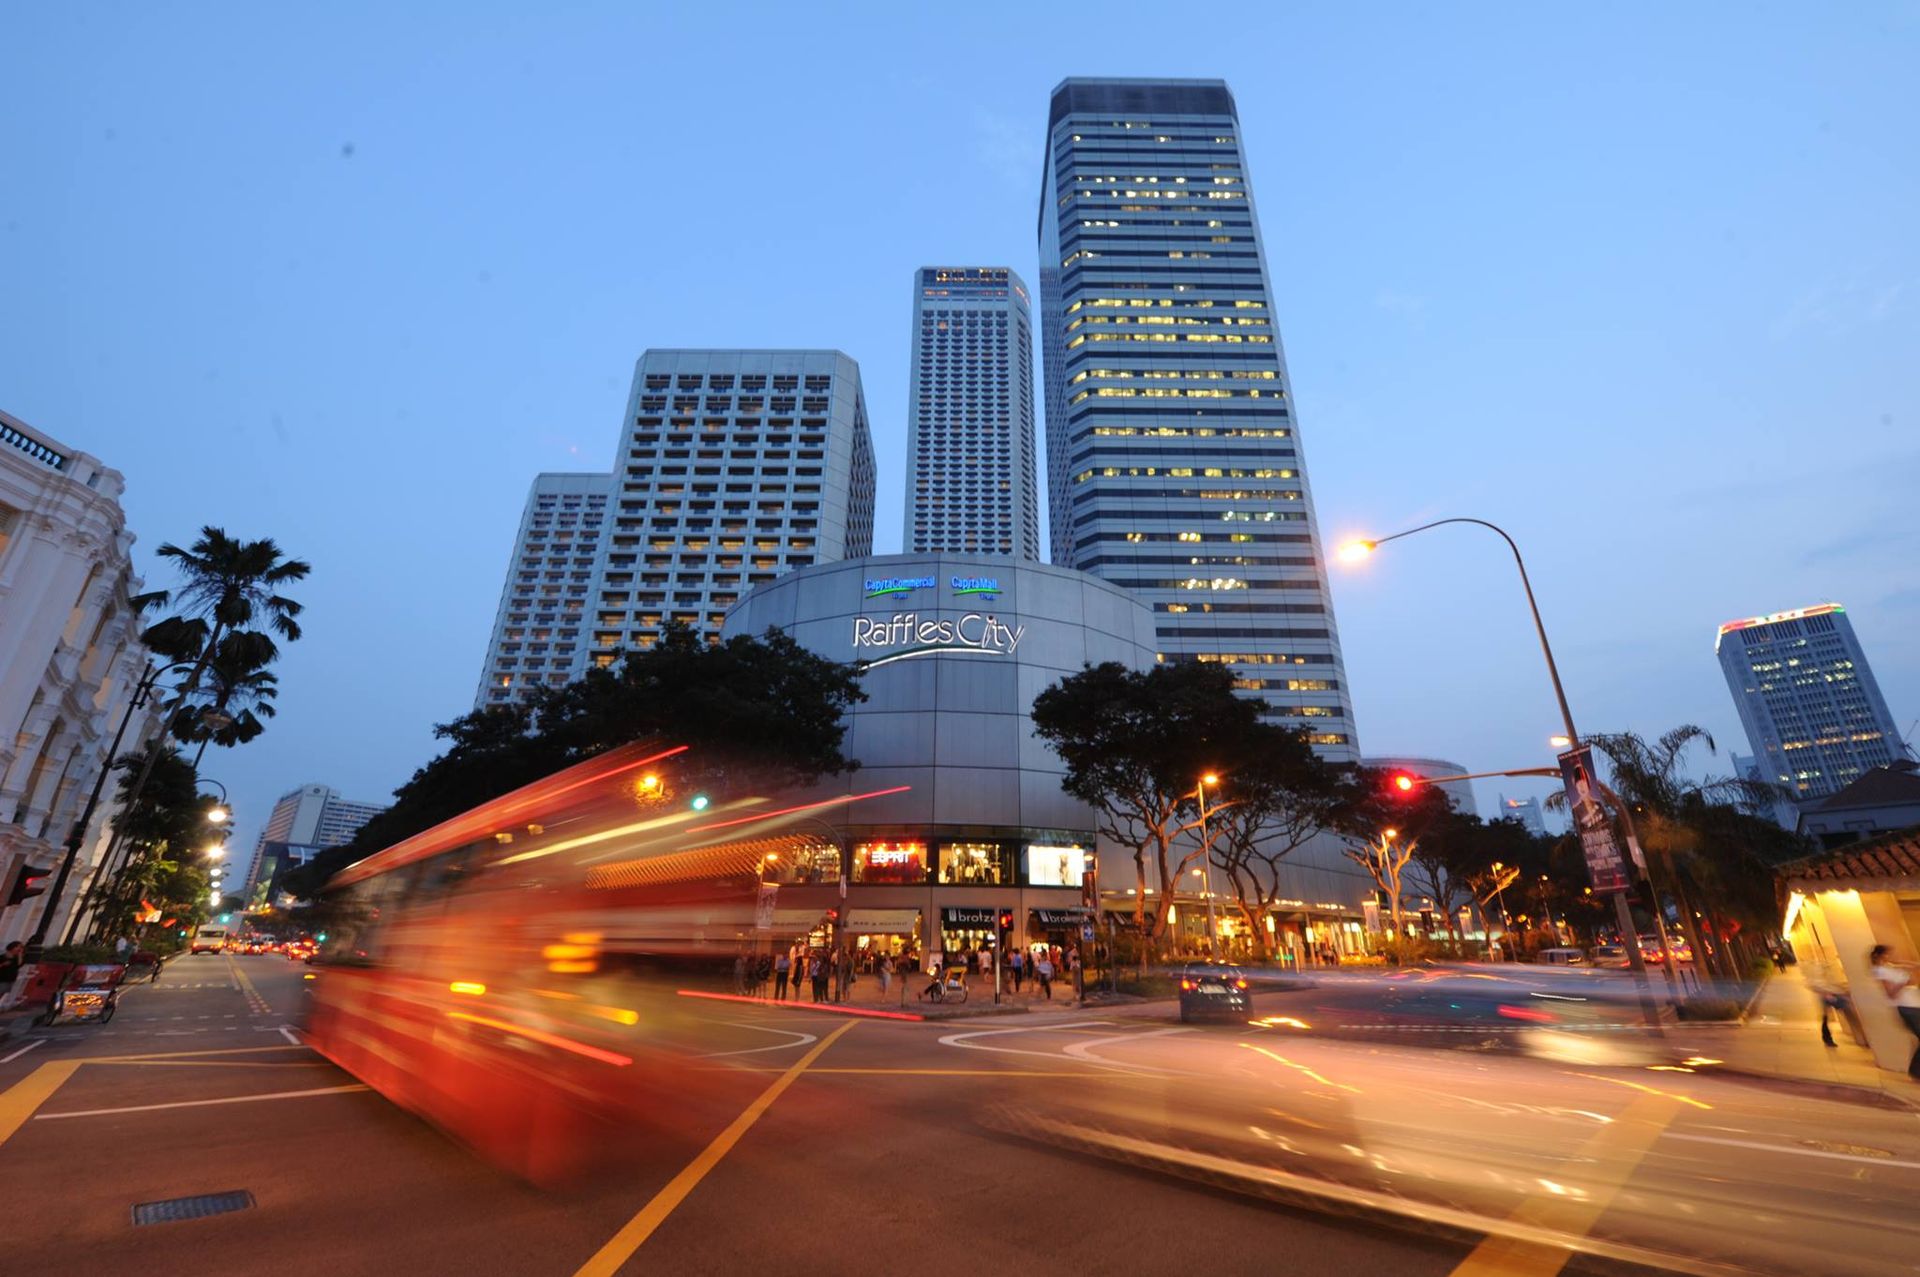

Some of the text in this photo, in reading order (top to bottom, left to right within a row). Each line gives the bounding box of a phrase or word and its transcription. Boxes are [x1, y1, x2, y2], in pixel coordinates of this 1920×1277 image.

[865, 576, 935, 591] CapitaCommercial
[951, 576, 998, 590] CapitaMall
[852, 613, 1025, 654] Raffles City
[871, 850, 910, 863] ESPRIT
